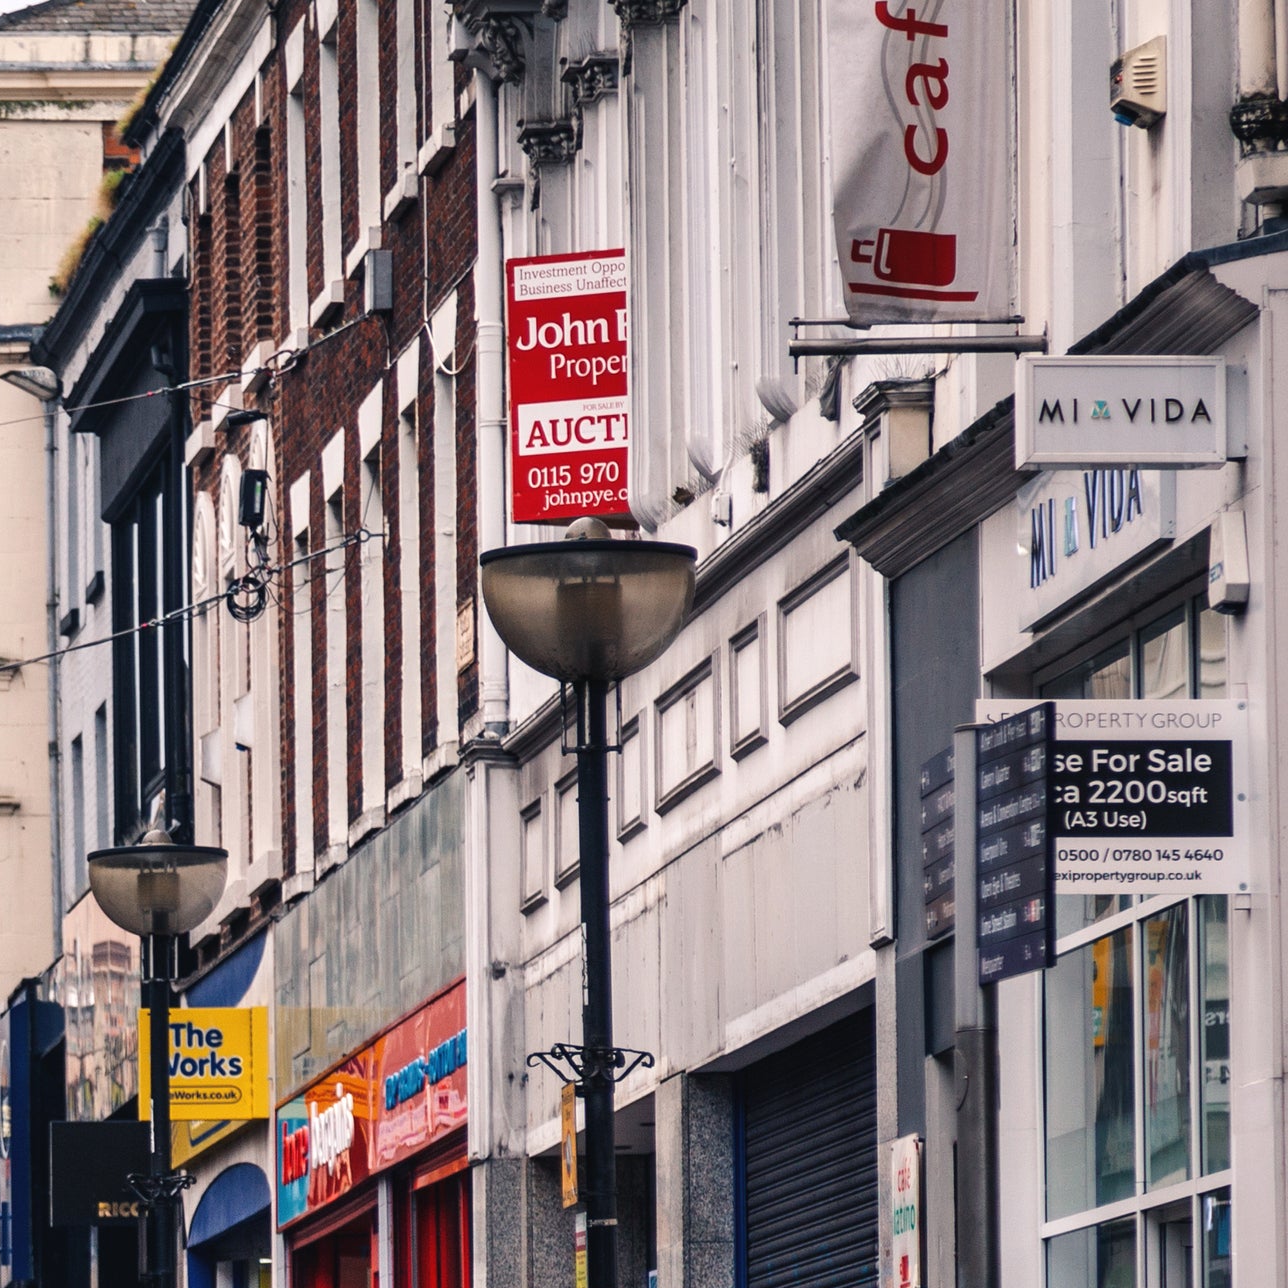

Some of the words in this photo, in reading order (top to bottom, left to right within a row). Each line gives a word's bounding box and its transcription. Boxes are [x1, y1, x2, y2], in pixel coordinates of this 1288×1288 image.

[519, 264, 587, 281] Investment
[519, 281, 572, 297] Business
[516, 312, 610, 351] John
[583, 403, 597, 411] FOR
[598, 402, 614, 411] SALE
[1039, 398, 1078, 423] MI
[1122, 398, 1211, 423] VIDA
[528, 465, 571, 489] 0115
[580, 461, 619, 485] 970
[1054, 712, 1147, 729] ROPERTY
[1151, 712, 1223, 729] GROUP
[1092, 749, 1140, 773] For
[1147, 748, 1213, 773] Sale
[1064, 811, 1099, 829] (A3
[1103, 811, 1148, 829] Use)
[1058, 849, 1100, 862] 0500
[1112, 849, 1153, 862] 0780
[1155, 849, 1181, 862] 145
[1184, 849, 1224, 862] 4640
[170, 1022, 224, 1049] The
